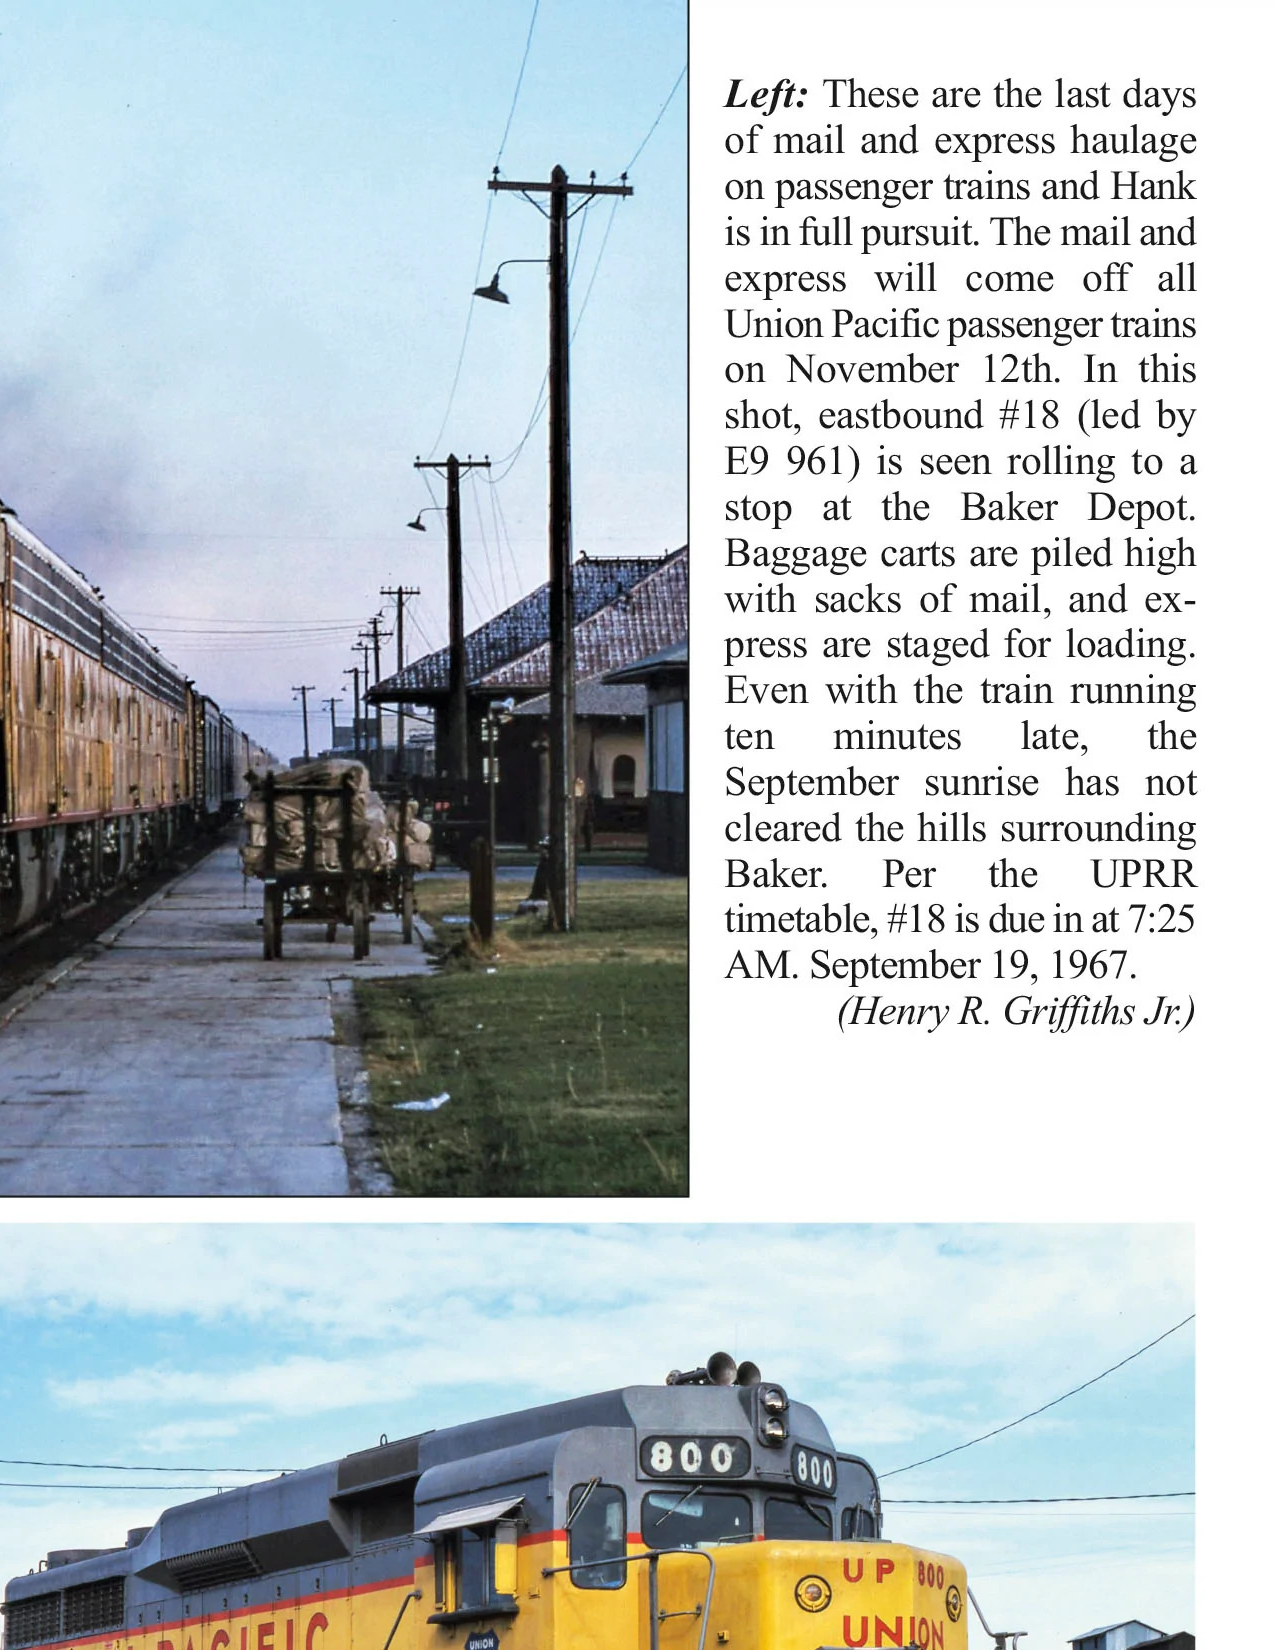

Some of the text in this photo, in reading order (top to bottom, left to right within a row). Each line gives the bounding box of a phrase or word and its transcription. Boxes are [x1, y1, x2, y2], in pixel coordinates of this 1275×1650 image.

[650, 1440, 733, 1473] 800
[797, 1450, 833, 1489] 800
[918, 1560, 944, 1590] 800
[469, 1638, 494, 1650] UNION
